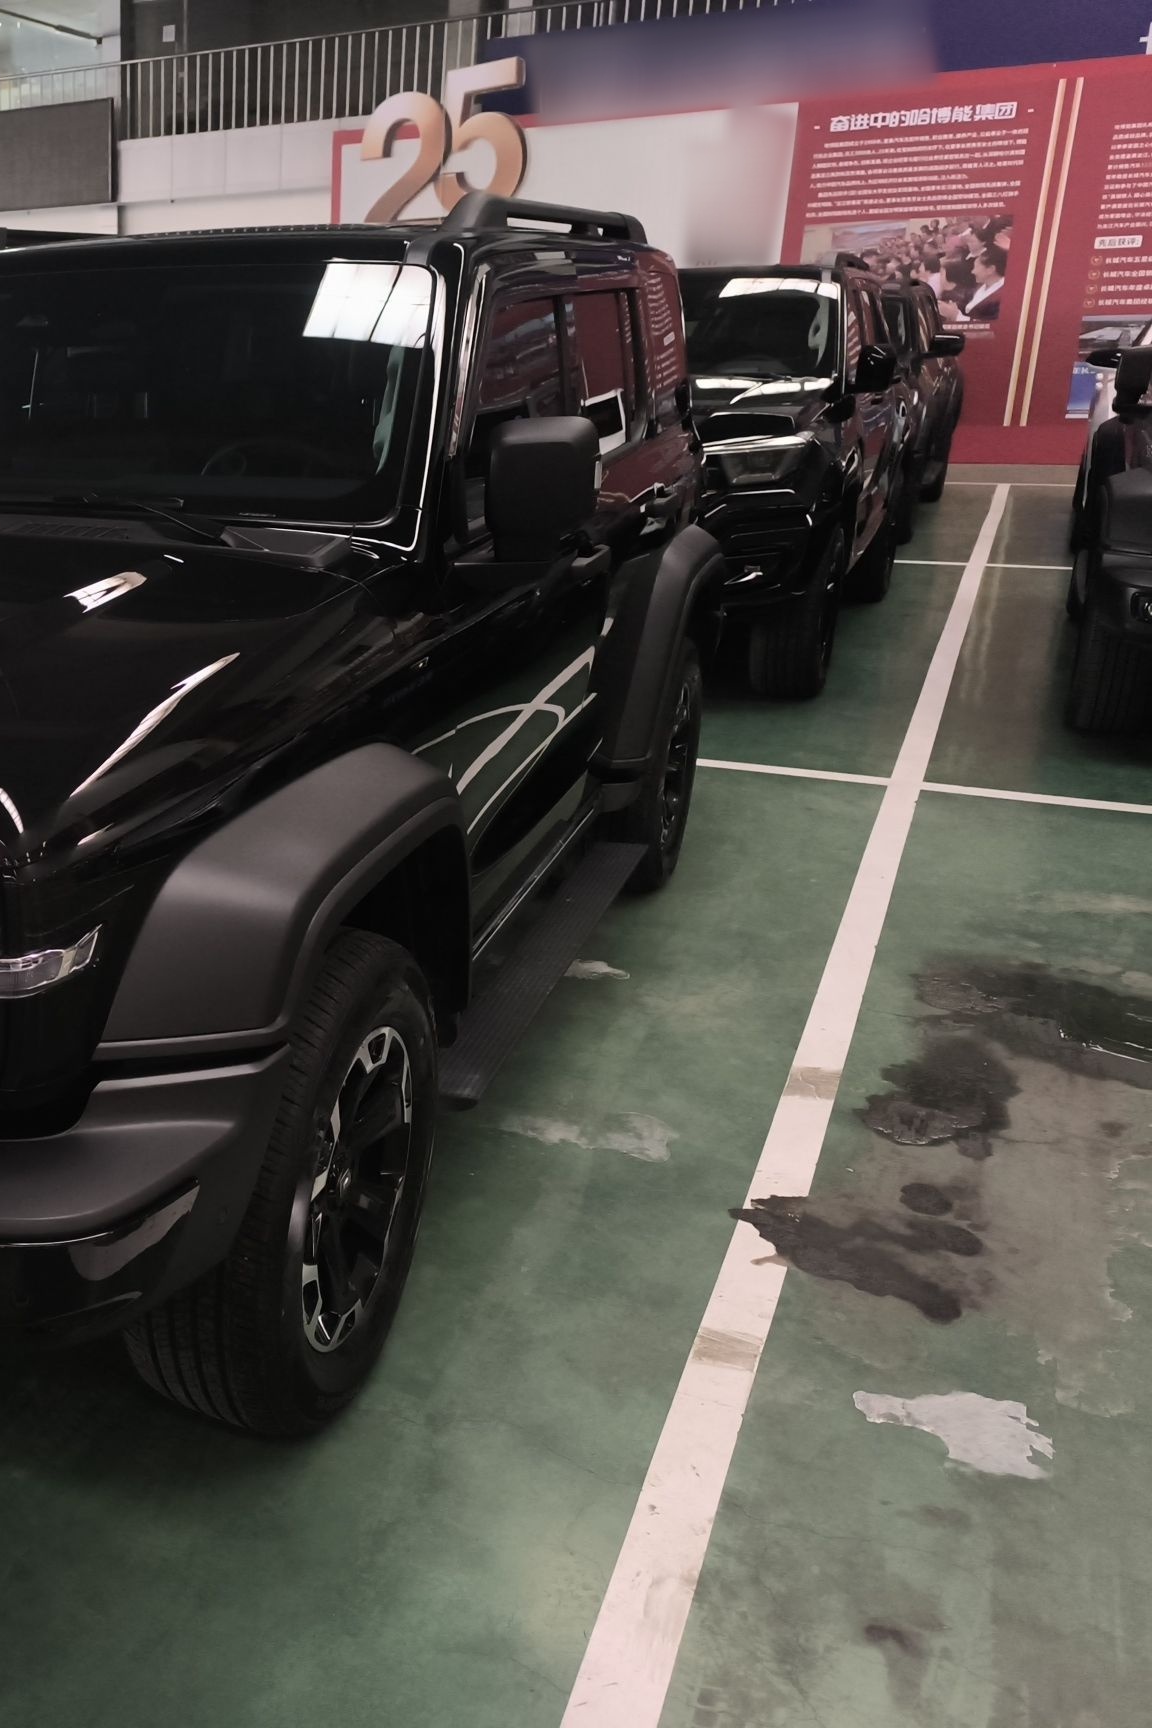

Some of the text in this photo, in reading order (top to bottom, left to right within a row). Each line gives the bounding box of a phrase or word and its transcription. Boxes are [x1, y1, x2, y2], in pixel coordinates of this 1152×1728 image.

[361, 56, 527, 223] 25
[830, 102, 1018, 132] 奋进中的哈博能集团
